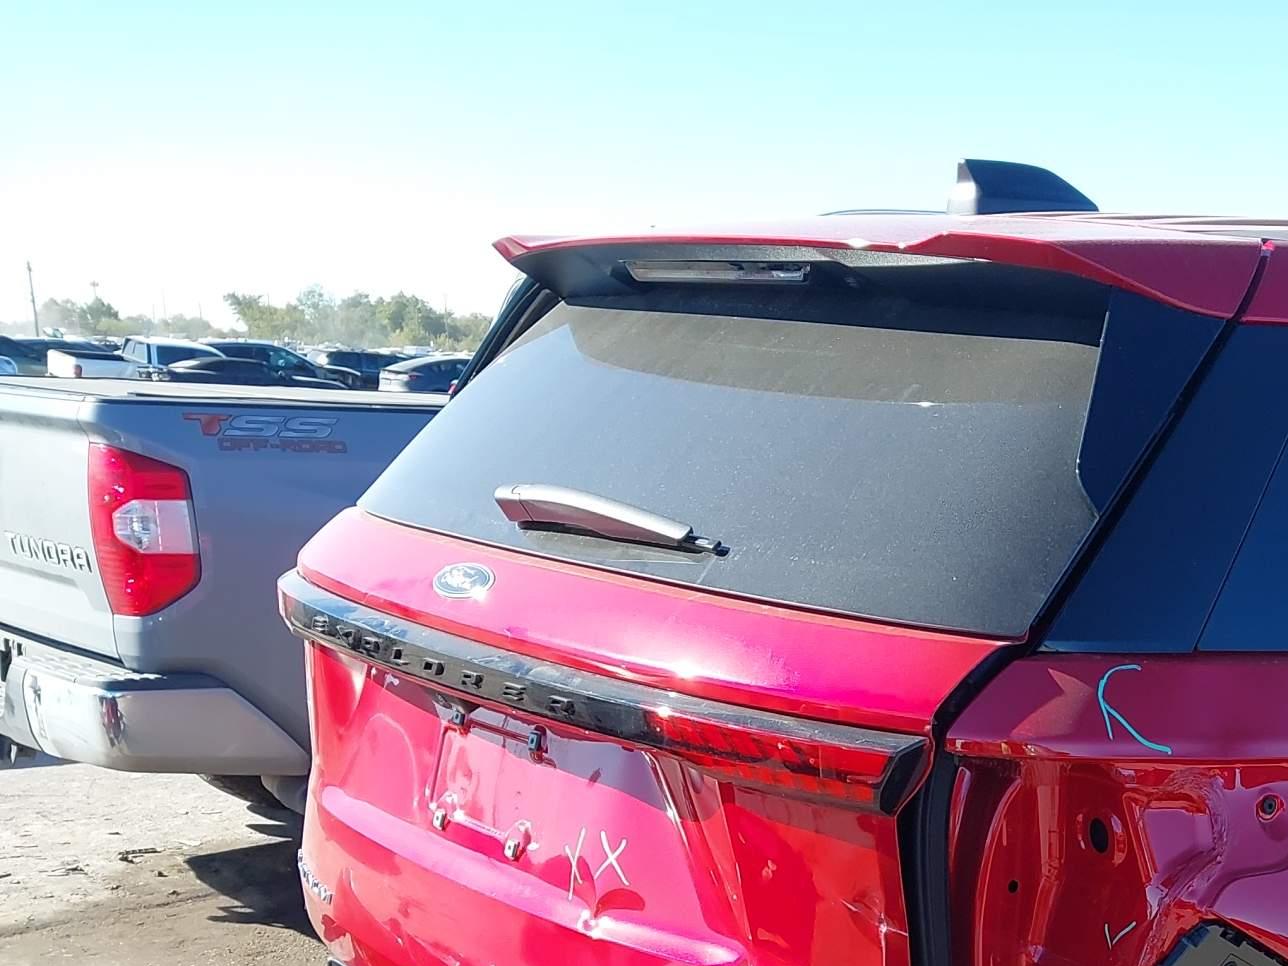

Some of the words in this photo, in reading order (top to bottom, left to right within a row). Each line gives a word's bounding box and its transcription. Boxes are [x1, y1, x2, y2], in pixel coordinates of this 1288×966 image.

[182, 412, 340, 439] TSS
[4, 530, 93, 574] TUNDRA
[311, 615, 577, 721] EXPLORER
